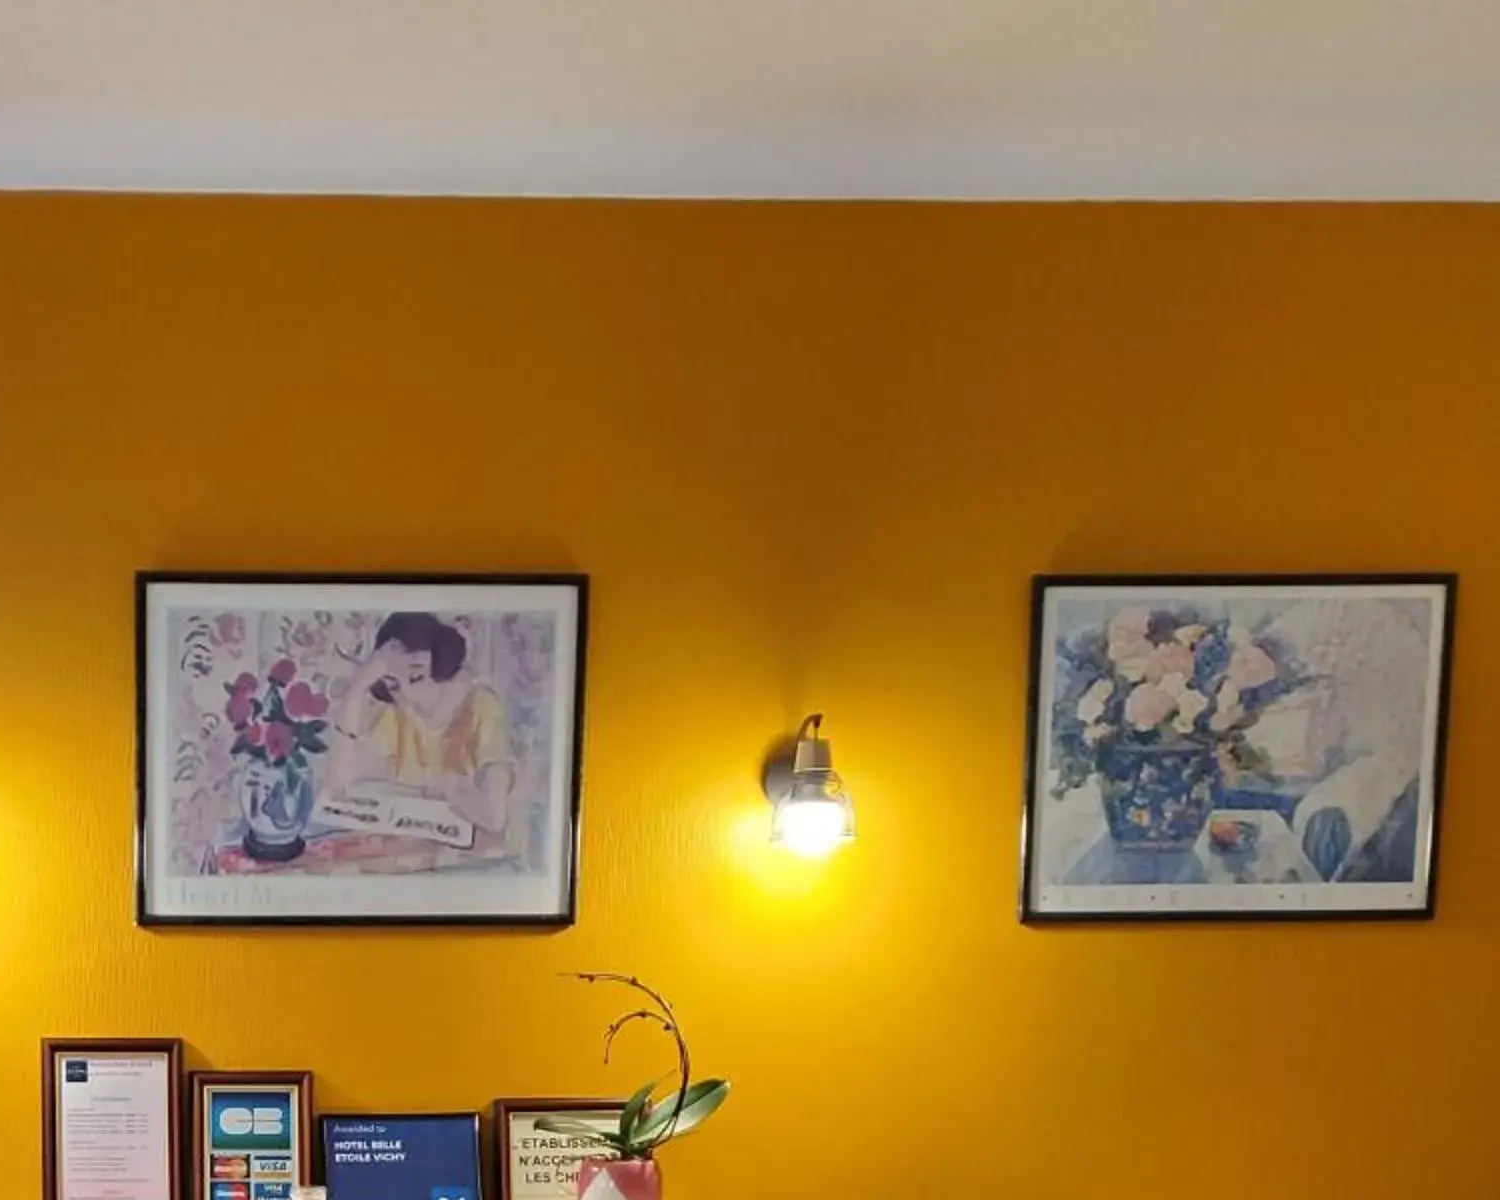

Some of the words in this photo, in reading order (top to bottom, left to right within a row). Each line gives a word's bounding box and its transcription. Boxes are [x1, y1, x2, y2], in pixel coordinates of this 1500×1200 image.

[219, 1107, 283, 1135] CB
[333, 1123, 375, 1133] Awarded
[376, 1124, 387, 1133] to
[334, 1140, 368, 1150] HOTEL
[371, 1139, 402, 1149] BELLE
[335, 1153, 371, 1163] ETOILE
[373, 1152, 406, 1162] VICHY
[525, 1172, 551, 1183] LES
